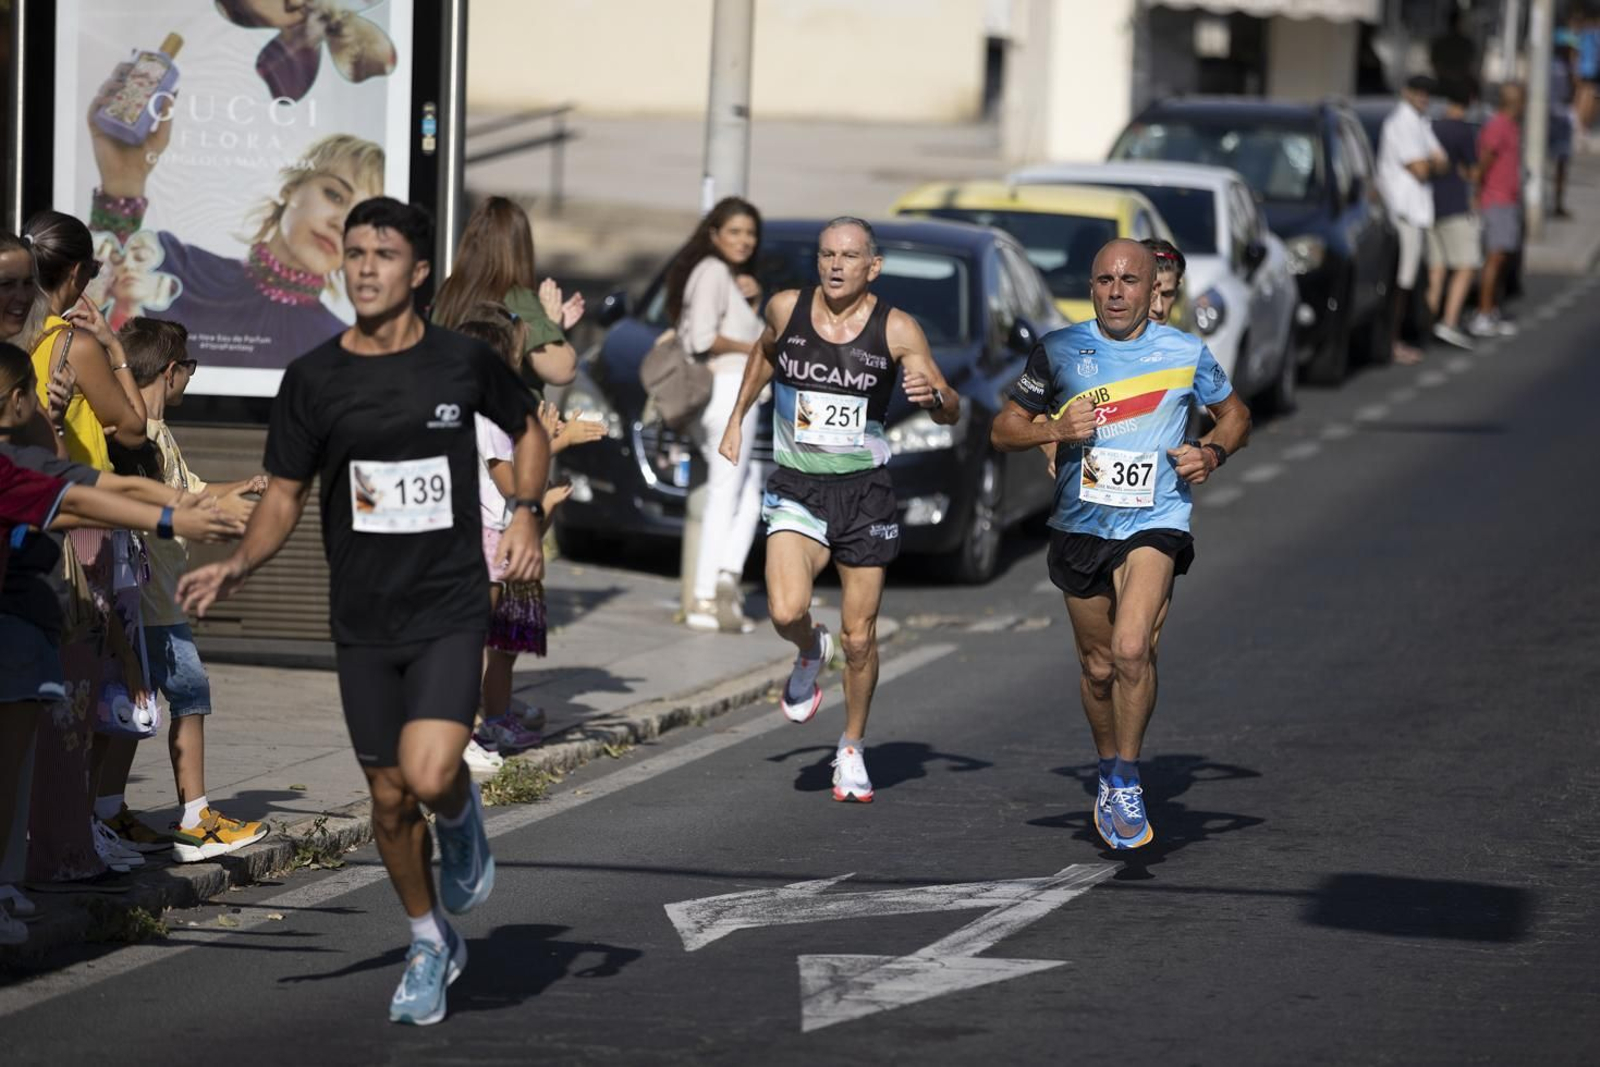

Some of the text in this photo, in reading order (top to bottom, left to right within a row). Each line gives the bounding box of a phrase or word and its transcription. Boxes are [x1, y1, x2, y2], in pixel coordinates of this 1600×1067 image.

[148, 91, 316, 132] GUCCI
[181, 130, 282, 150] FLORA
[786, 359, 878, 391] JUCAMP
[824, 404, 861, 427] 251
[1111, 461, 1153, 487] 367
[394, 474, 445, 505] 139
